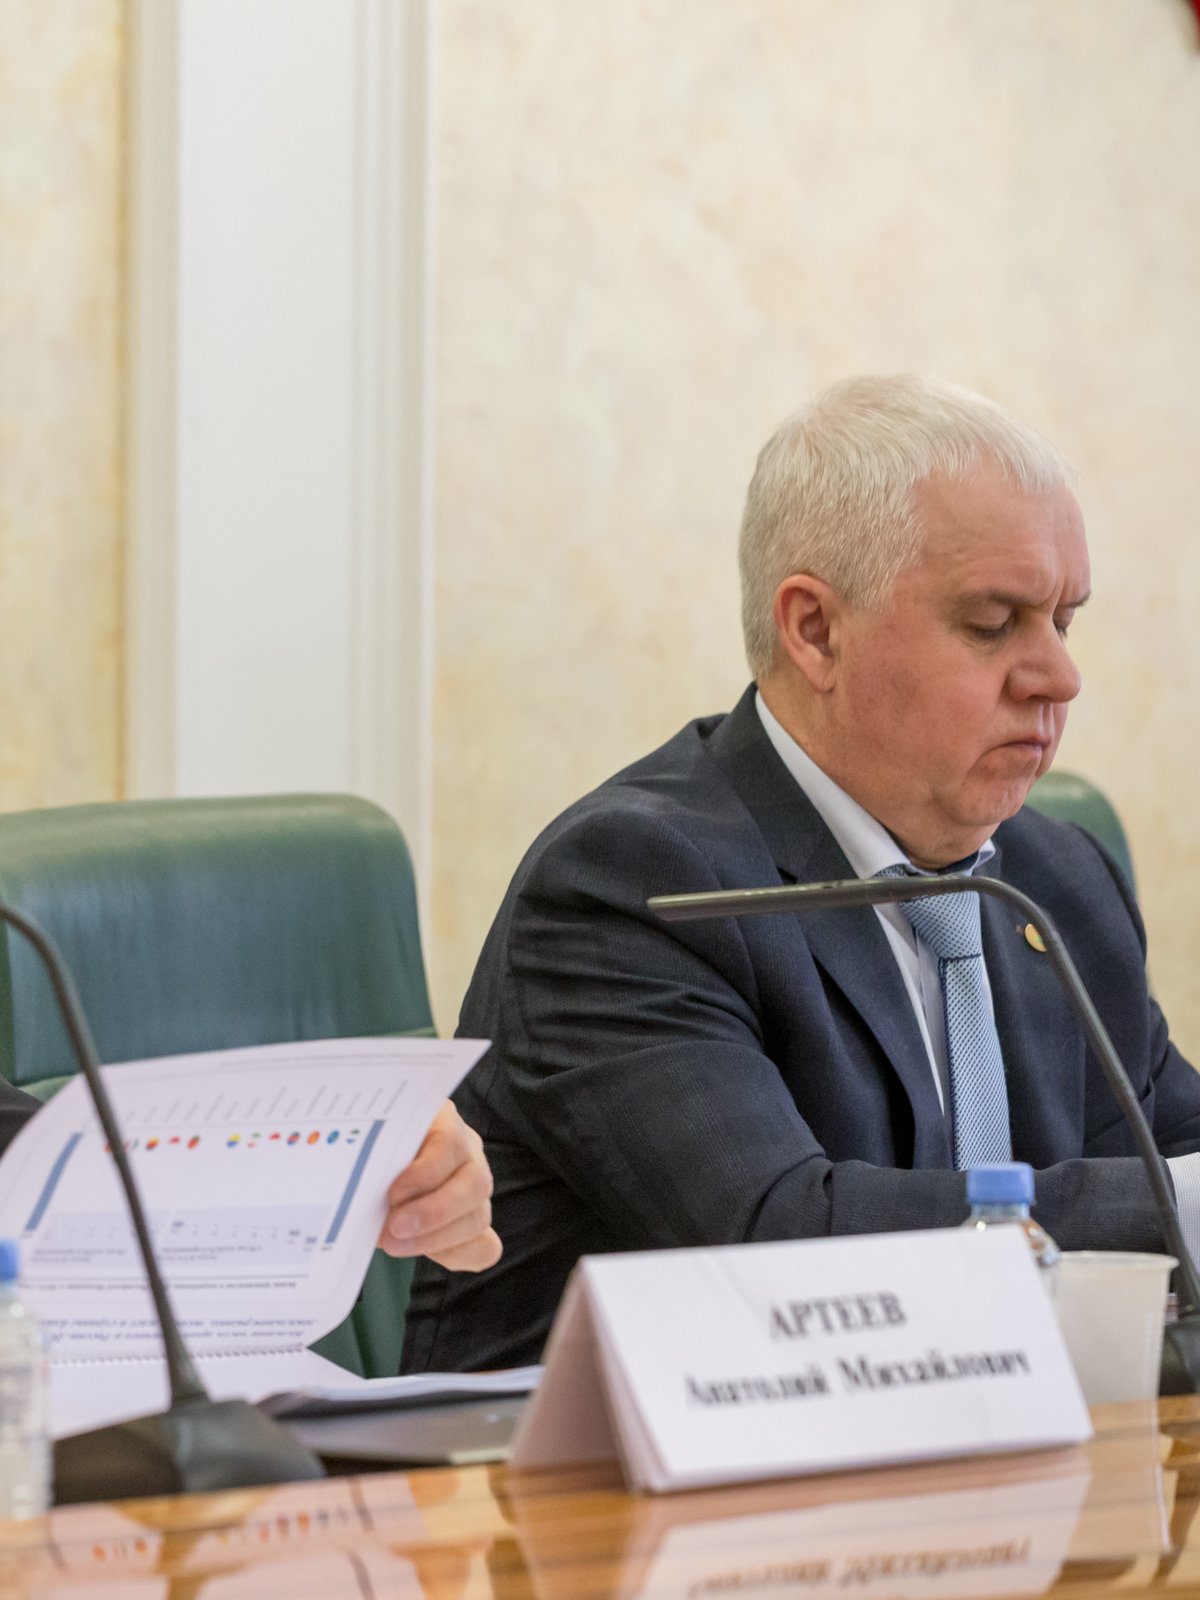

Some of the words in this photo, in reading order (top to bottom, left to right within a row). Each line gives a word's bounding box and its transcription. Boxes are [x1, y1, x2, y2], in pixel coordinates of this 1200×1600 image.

[770, 1291, 907, 1341] АРТЕЕВ
[686, 1364, 831, 1406] Анатолий
[836, 1348, 1032, 1391] Михайлович
